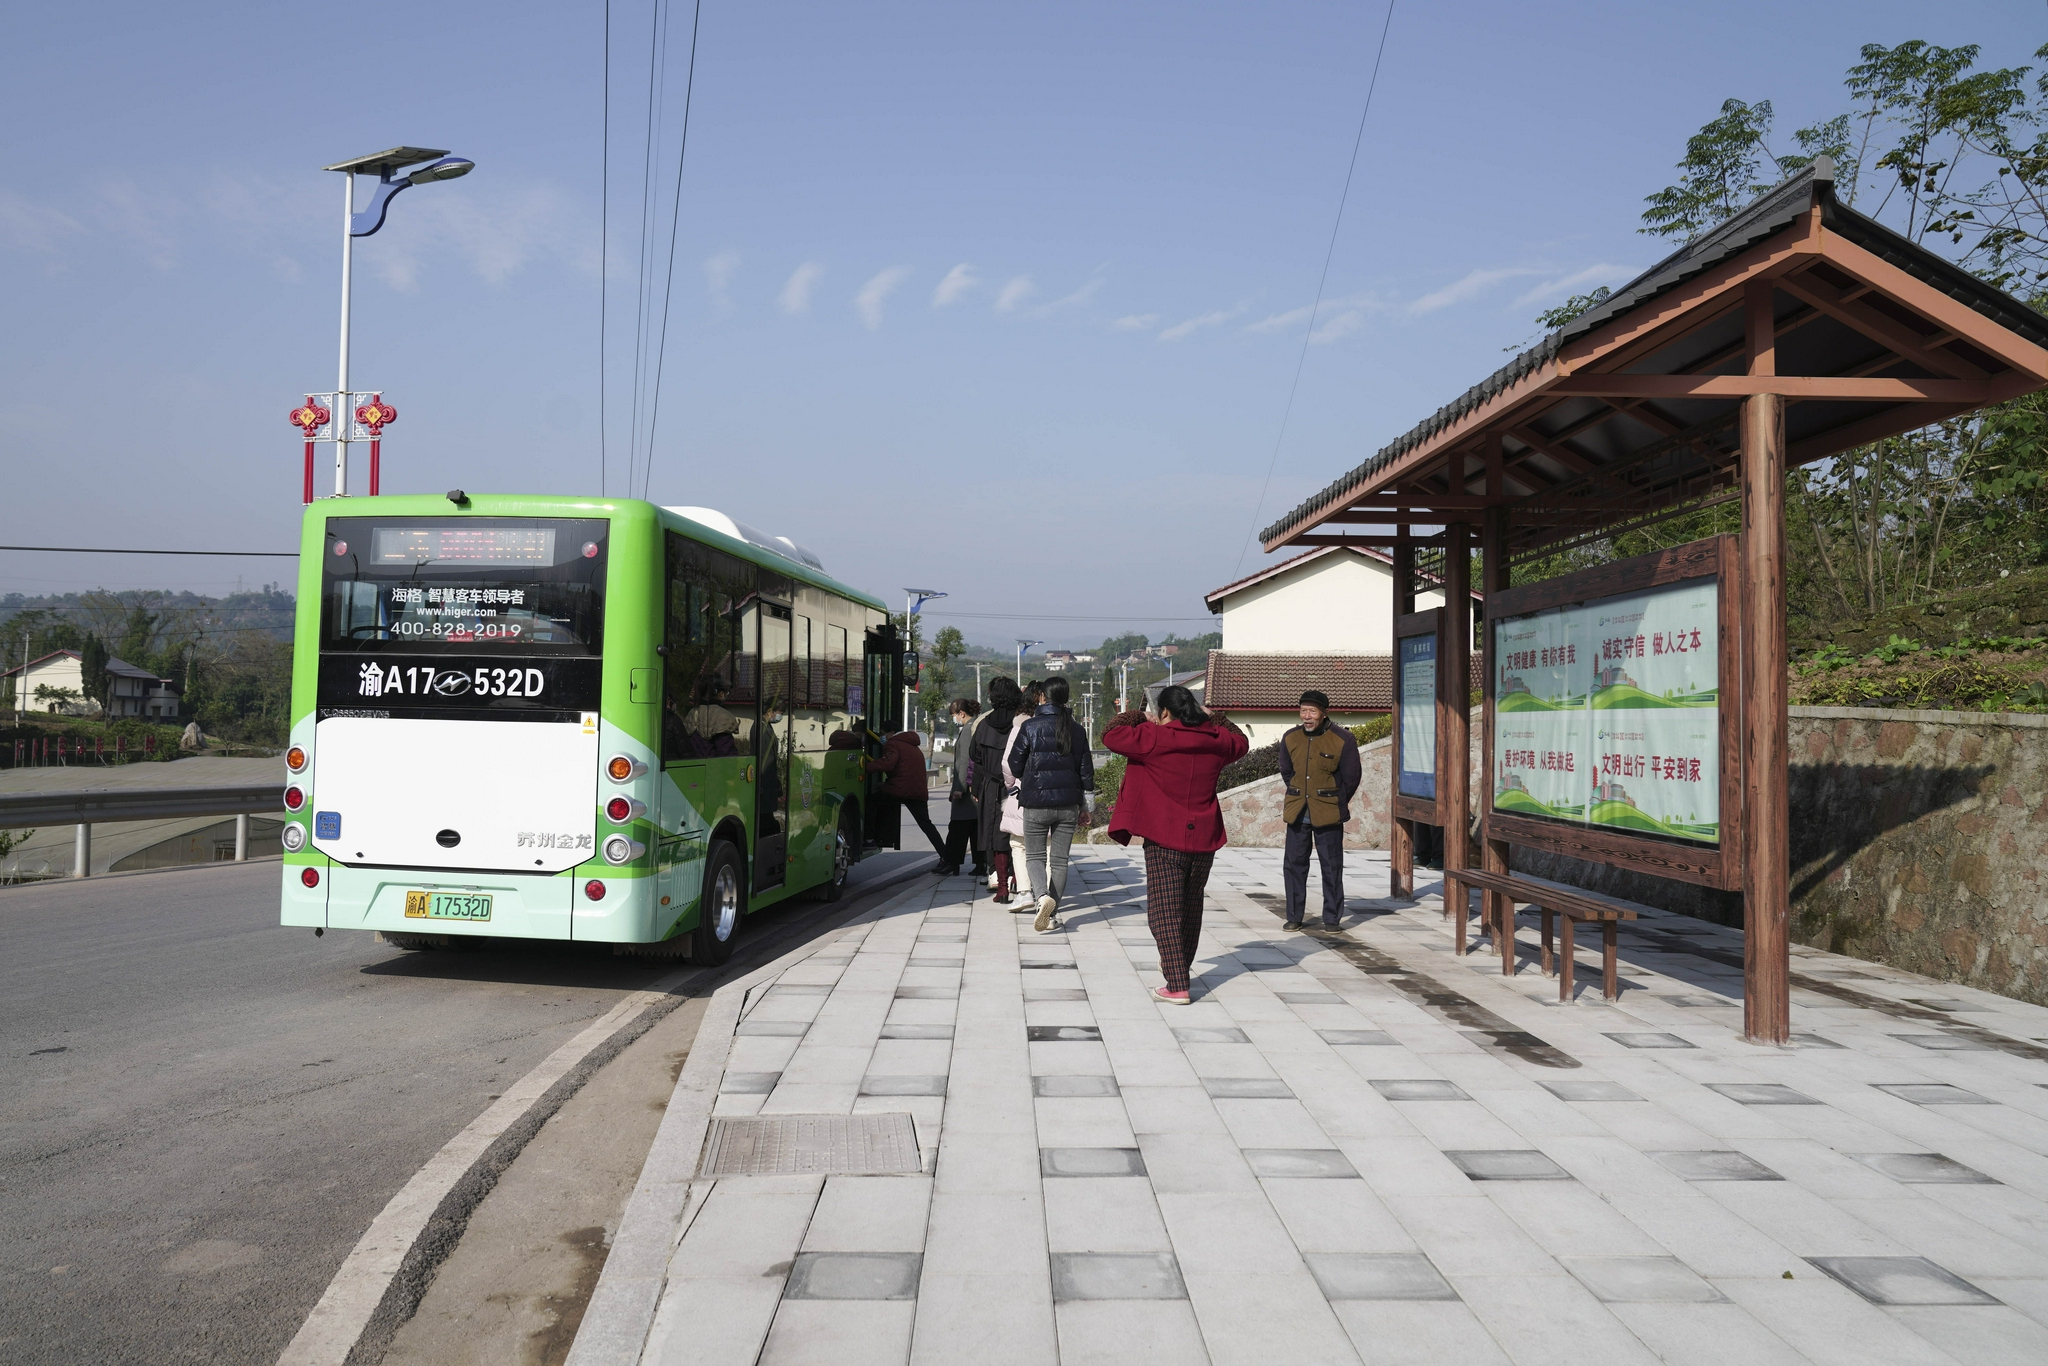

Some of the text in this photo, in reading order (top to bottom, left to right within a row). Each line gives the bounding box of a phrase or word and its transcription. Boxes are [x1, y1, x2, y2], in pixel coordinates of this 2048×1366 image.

[391, 588, 525, 605] 海格 智慧客车领导者
[416, 606, 497, 618] www.higer.com
[390, 621, 522, 637] 400-828-2019
[1602, 626, 1702, 661] 诚实守信 做人之本
[1506, 643, 1576, 671] 文明健康 有你有我
[358, 662, 545, 697] 渝A17 532D
[1504, 749, 1575, 772] 爱护环境 从我做起
[1602, 753, 1702, 782] 文明出行 平安到家
[517, 832, 593, 850] 苏州金龙
